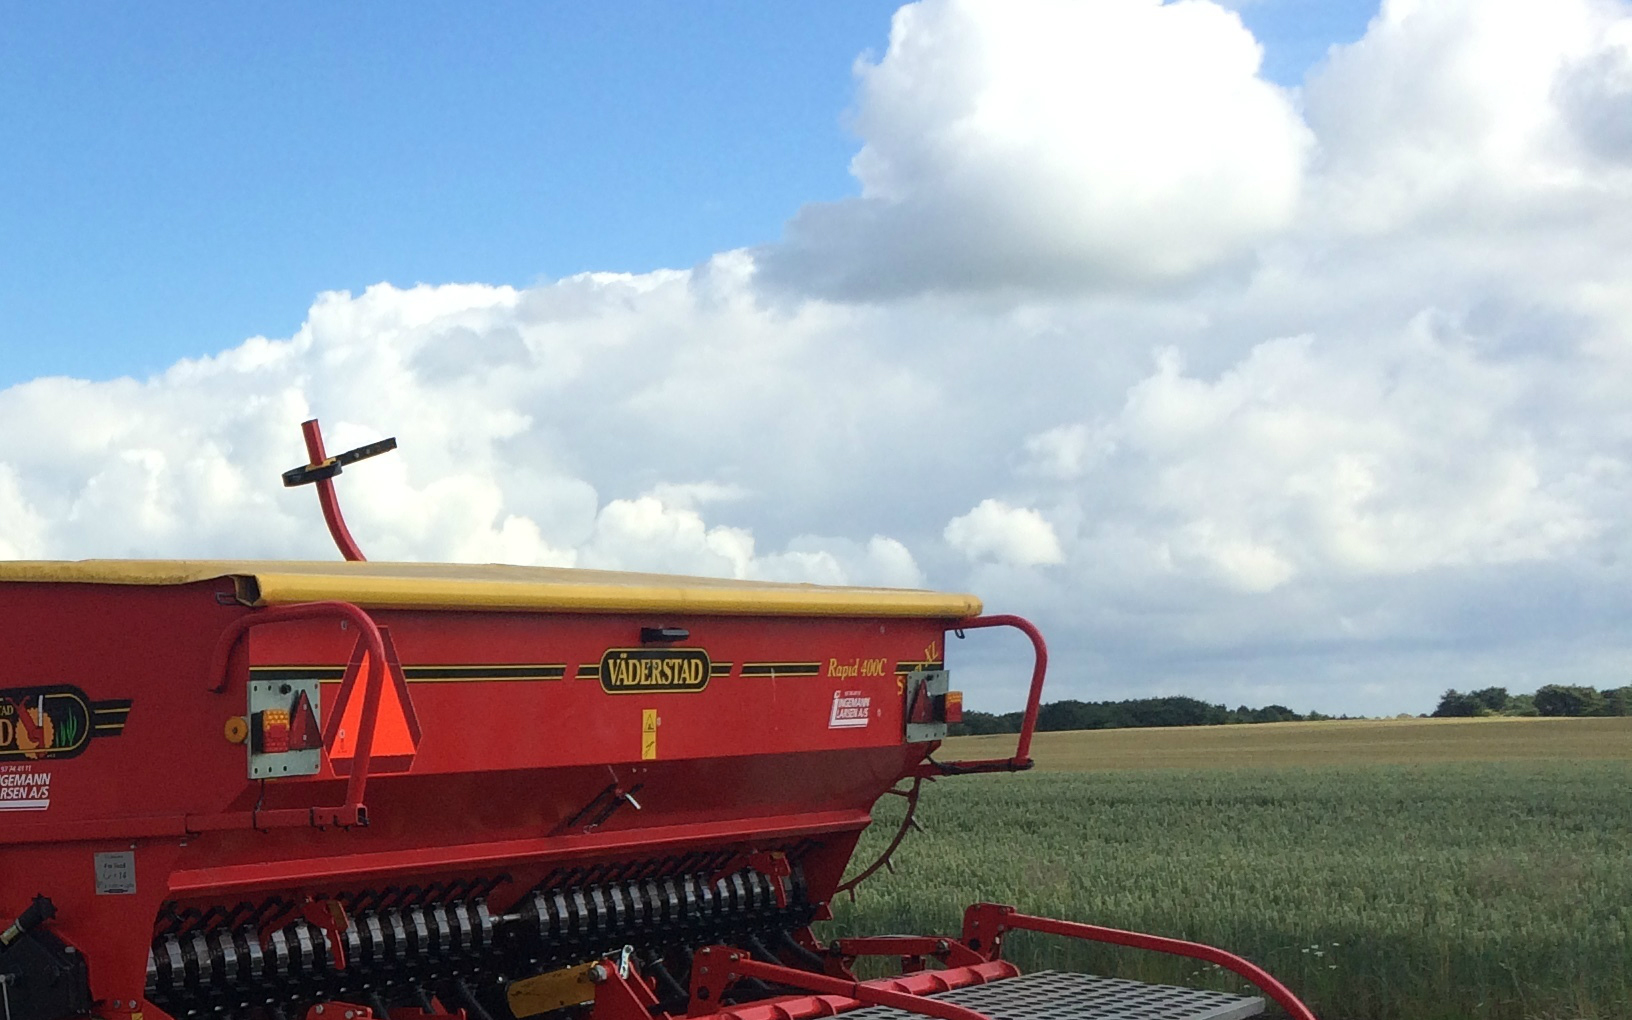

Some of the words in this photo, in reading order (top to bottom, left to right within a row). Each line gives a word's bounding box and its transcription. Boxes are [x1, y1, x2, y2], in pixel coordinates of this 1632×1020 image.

[924, 641, 939, 667] XL
[607, 653, 703, 686] VÄDERSTAD
[827, 658, 860, 681] Rapid
[860, 658, 888, 677] 400C
[29, 786, 49, 799] A/S
